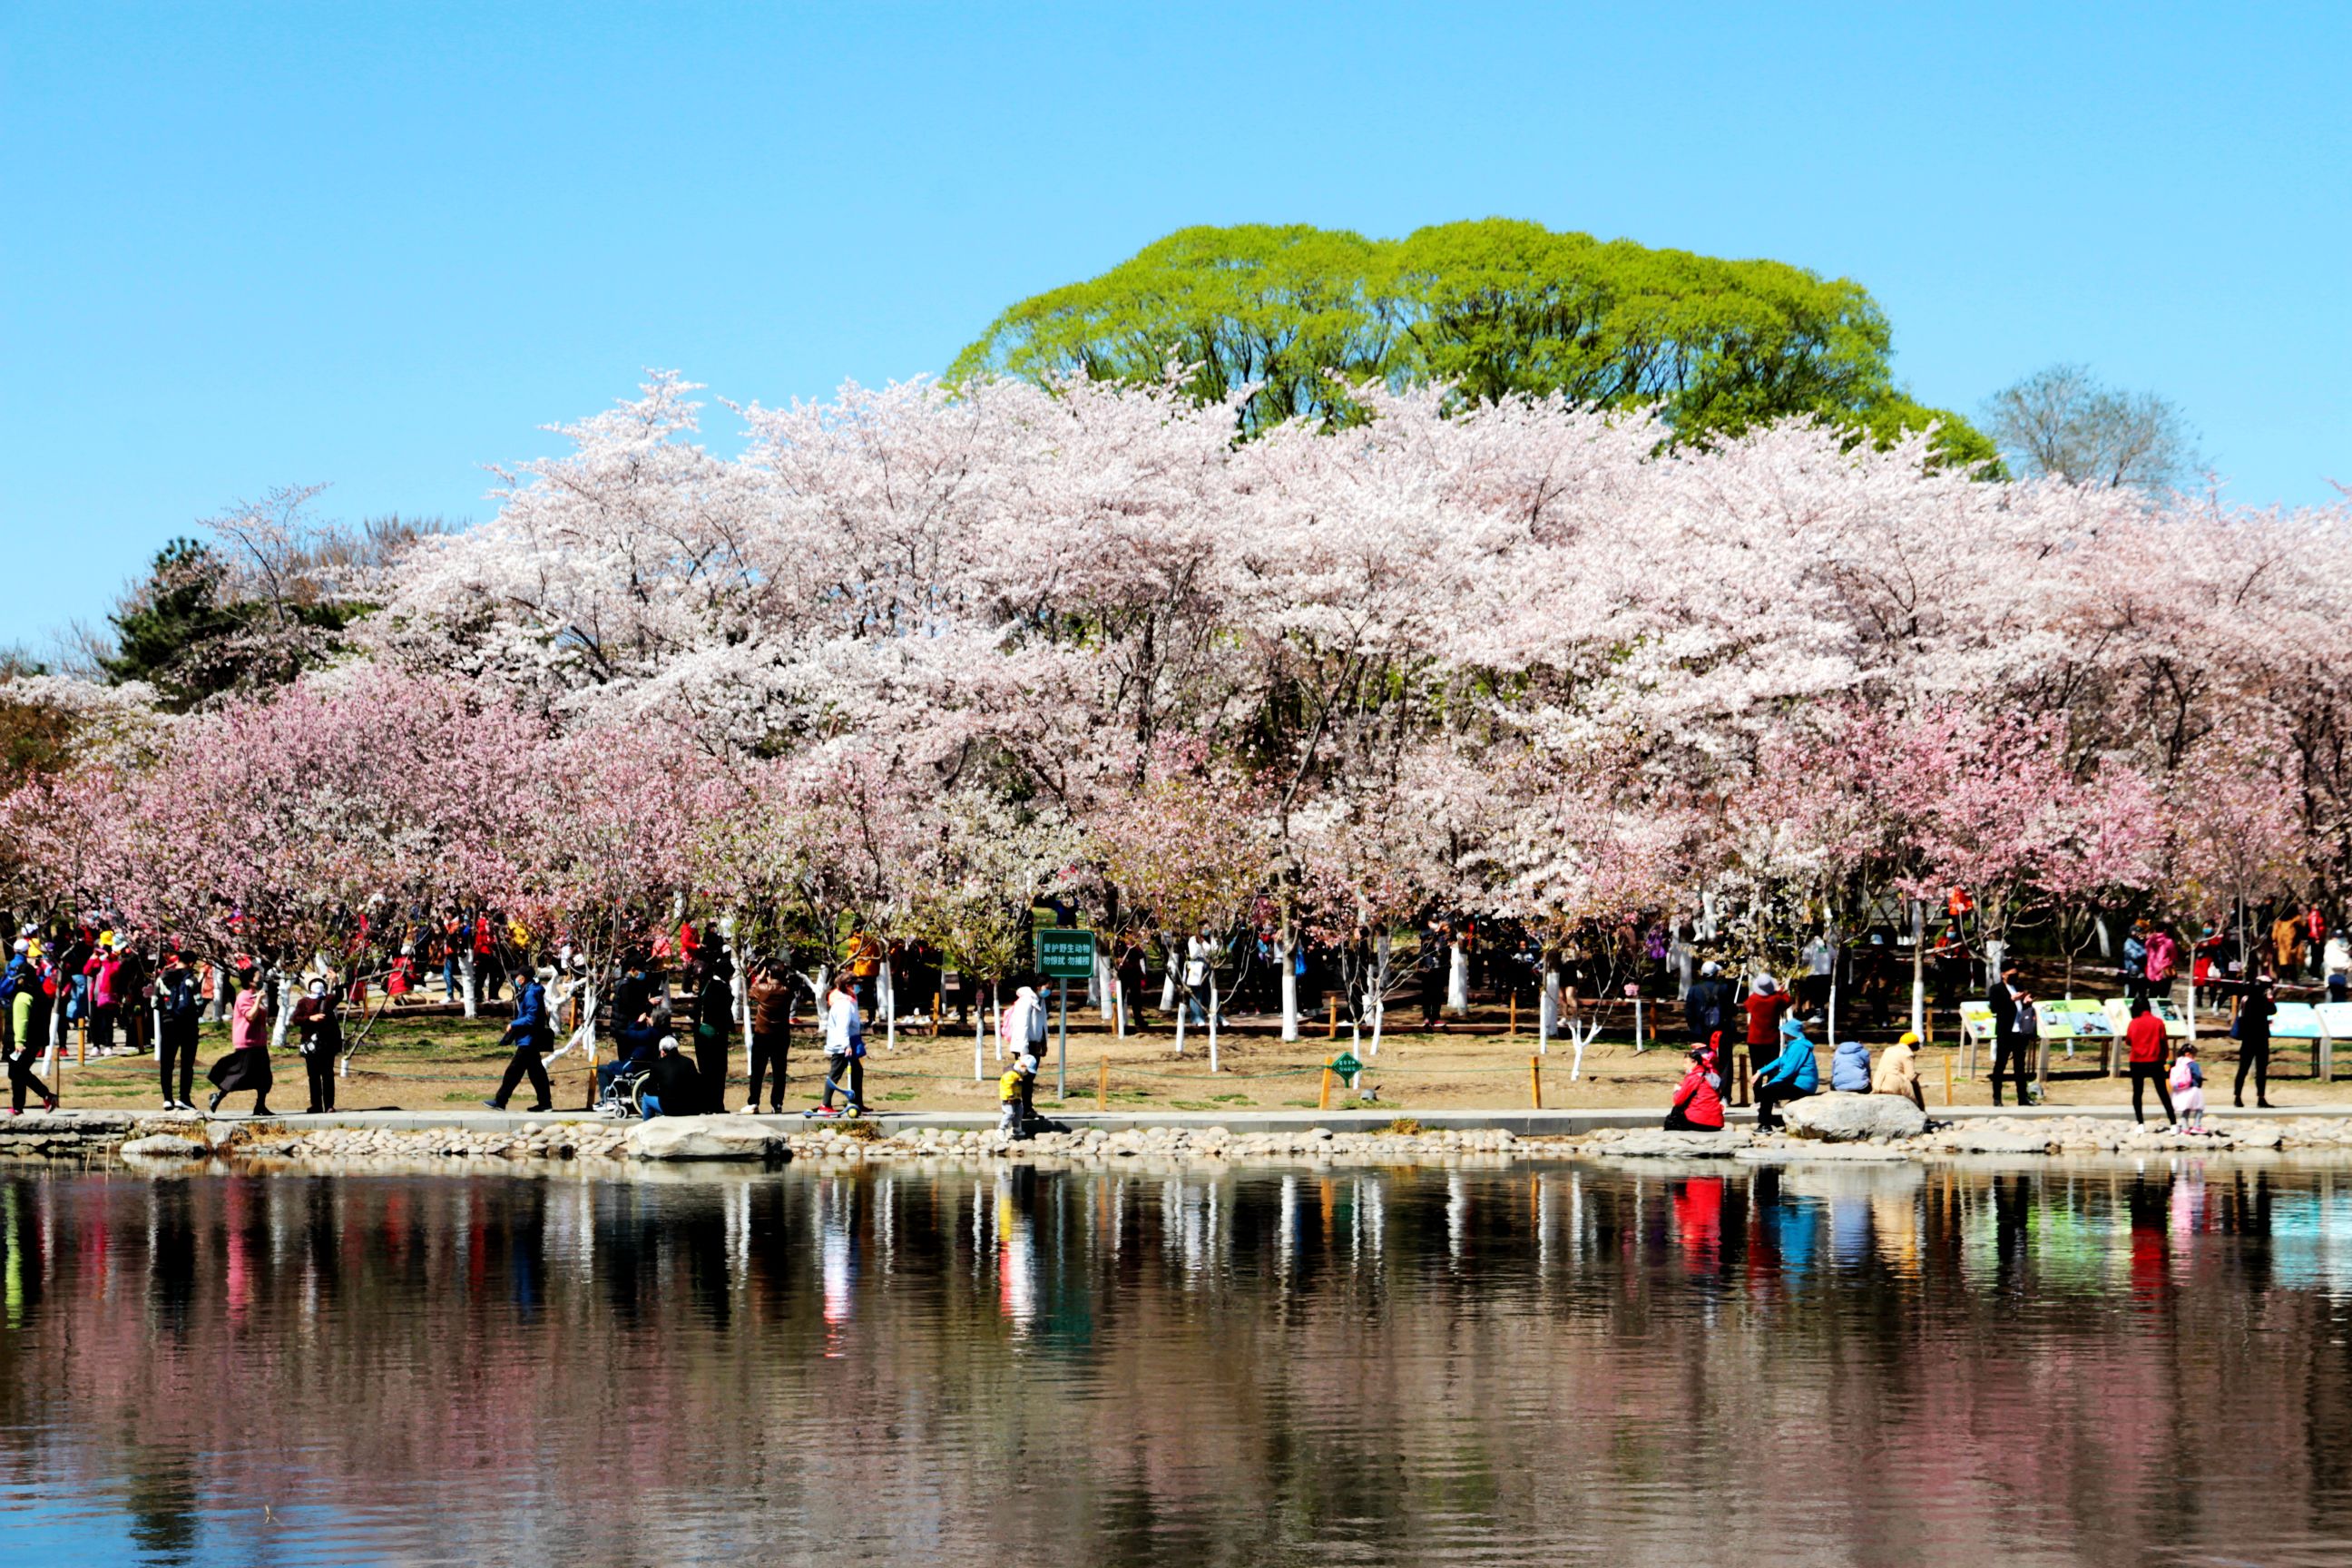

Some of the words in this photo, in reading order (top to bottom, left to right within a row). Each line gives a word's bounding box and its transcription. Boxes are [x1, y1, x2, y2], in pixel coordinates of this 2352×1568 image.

[1044, 943, 1091, 954] 爱护野生动物
[1043, 956, 1065, 965] 勿惊扰
